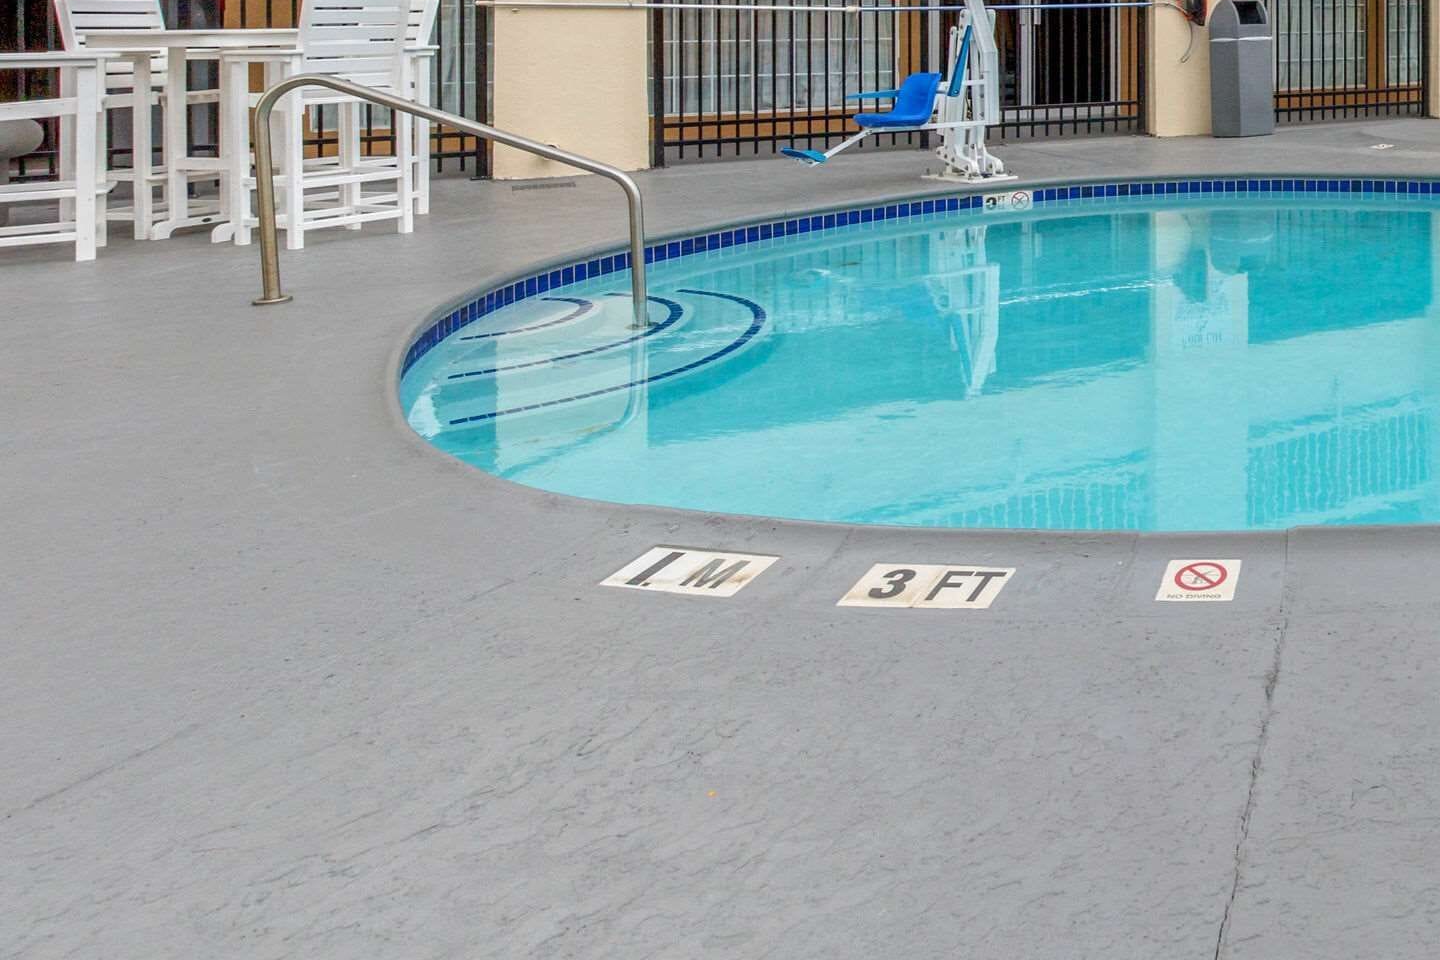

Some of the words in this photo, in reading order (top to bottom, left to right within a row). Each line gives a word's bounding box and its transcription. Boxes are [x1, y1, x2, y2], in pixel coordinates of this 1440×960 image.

[679, 558, 751, 589] M
[868, 569, 917, 599] 3
[924, 570, 1007, 602] FT
